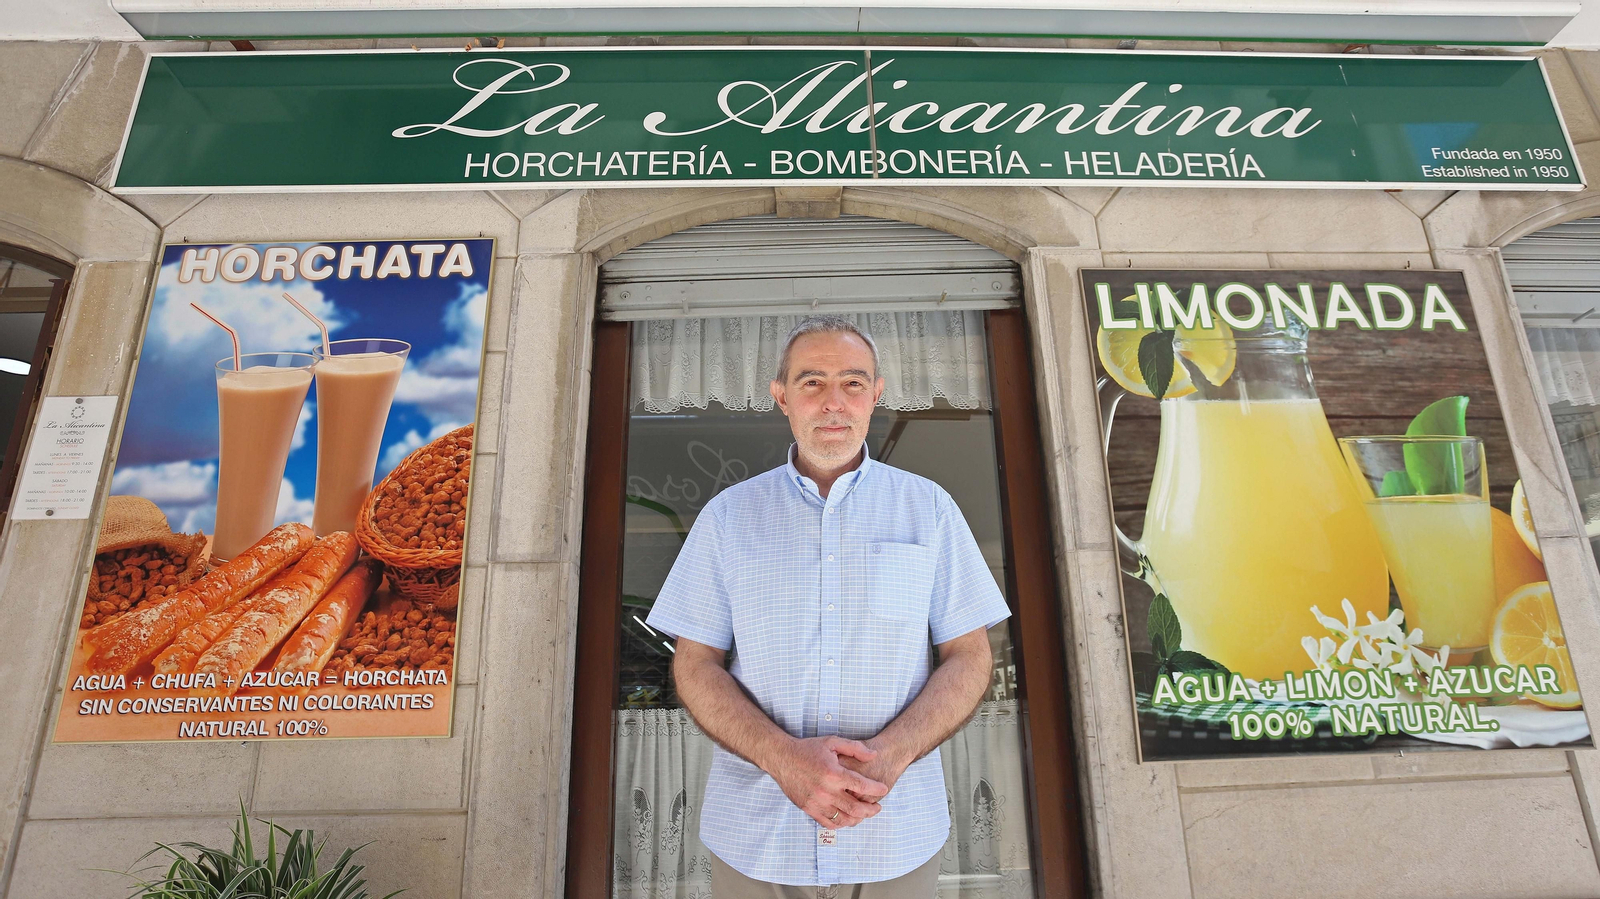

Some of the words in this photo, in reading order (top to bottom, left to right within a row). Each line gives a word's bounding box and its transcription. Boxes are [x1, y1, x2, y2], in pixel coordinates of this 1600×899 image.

[391, 58, 605, 138] La
[643, 58, 1322, 138] Alicantina
[464, 144, 732, 178] HORCHATERÍA
[770, 144, 1030, 176] BOMBONERÍA
[1064, 147, 1266, 178] HELADERÍA
[1431, 147, 1499, 160] Fundada
[1502, 151, 1522, 160] en
[1525, 148, 1563, 160] 1950
[1421, 165, 1510, 178] Established
[1513, 165, 1528, 177] in
[1531, 165, 1569, 178] 1950
[178, 242, 474, 284] HORCHATA
[1095, 282, 1468, 331] LIMONADA
[72, 674, 126, 692] AGUA
[151, 672, 216, 690] CHUFA
[240, 667, 319, 687] AZÚCAR
[343, 669, 448, 686] HORCHATA
[1153, 672, 1251, 706] AGUA
[1284, 667, 1394, 701] LIMON
[1429, 665, 1561, 697] AZUCAR
[78, 699, 113, 716] SIN
[117, 695, 274, 714] CONSERVANTES
[277, 695, 299, 712] NI
[302, 693, 434, 711] COLORANTES
[1228, 709, 1314, 741] 100%
[1332, 702, 1501, 736] NATURAL.
[179, 720, 270, 738] NATURAL
[276, 719, 328, 736] 100%
